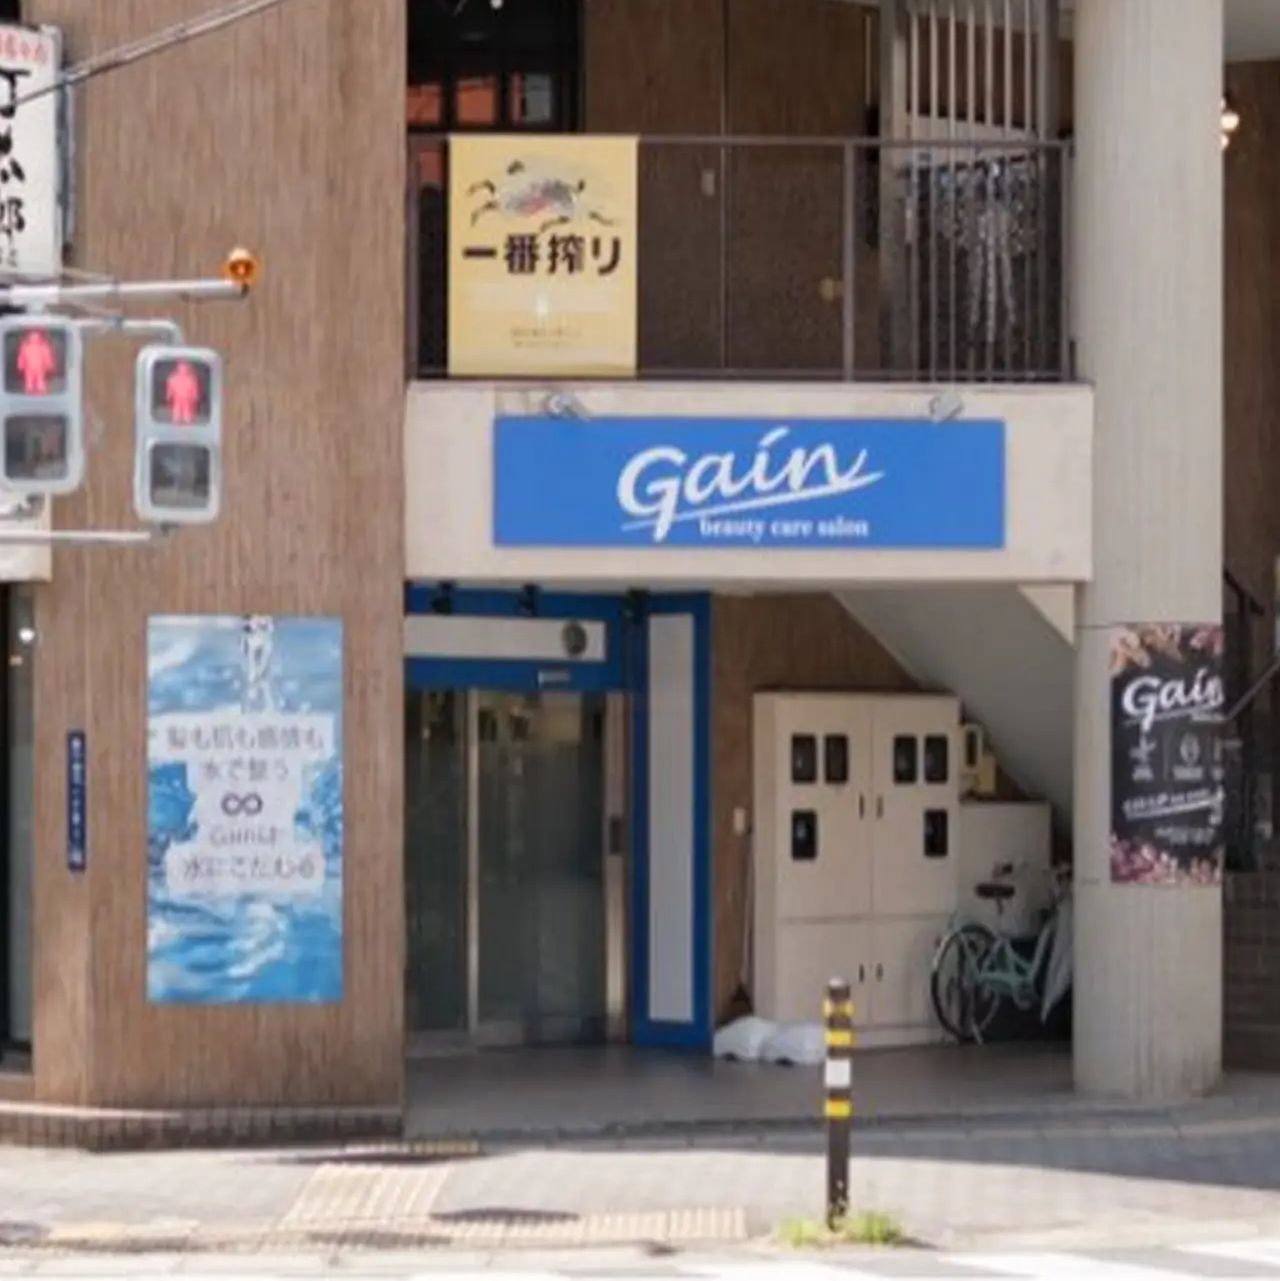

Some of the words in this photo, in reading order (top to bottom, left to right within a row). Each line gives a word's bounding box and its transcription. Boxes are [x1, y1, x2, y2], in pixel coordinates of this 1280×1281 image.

[463, 234, 620, 275] 一番搾り
[616, 426, 884, 541] Gain
[700, 516, 763, 543] beauty
[771, 520, 813, 538] care
[818, 516, 869, 538] salon
